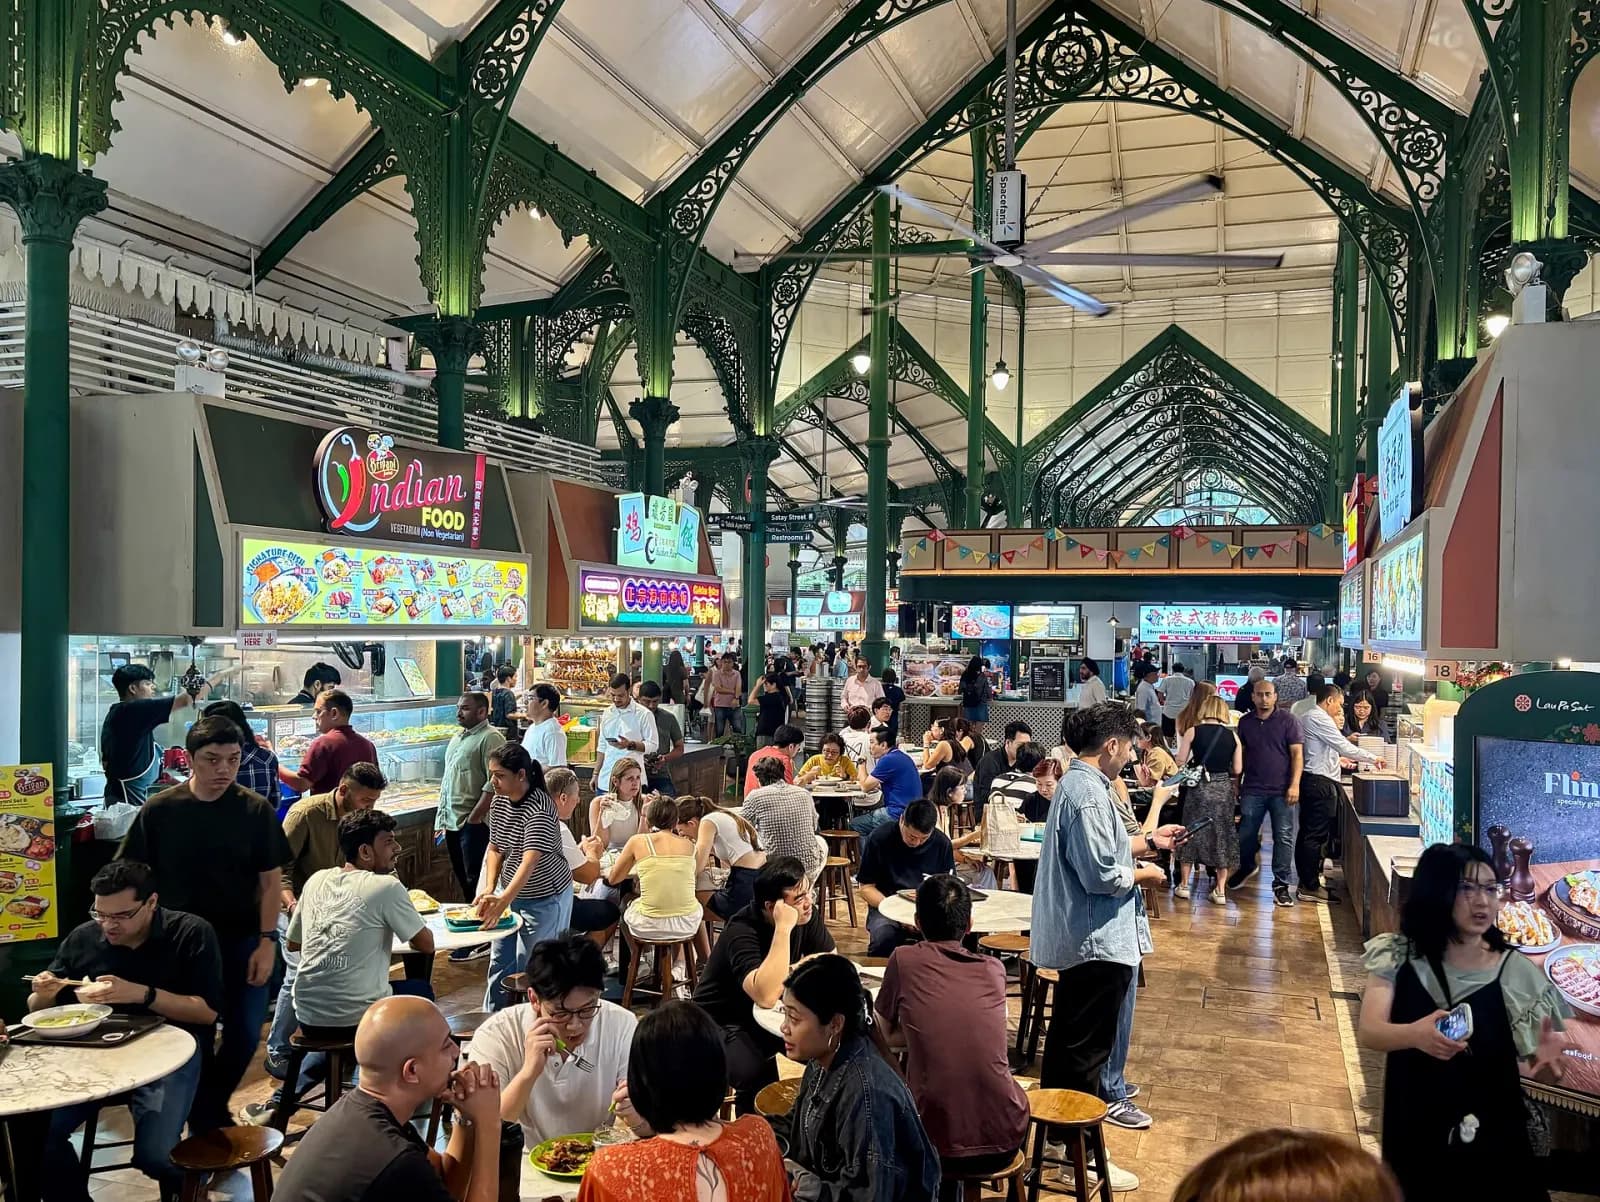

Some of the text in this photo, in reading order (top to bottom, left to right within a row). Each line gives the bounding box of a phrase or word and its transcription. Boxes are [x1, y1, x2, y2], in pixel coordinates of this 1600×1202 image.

[999, 176, 1008, 225] Spacefans
[421, 507, 465, 531] FOOD
[771, 513, 806, 522] Satay Street
[390, 523, 465, 543] VEGETARIAN (Non Vegetarian)
[771, 534, 804, 542] Restrooms
[246, 548, 287, 574] SIGNATURE
[244, 638, 261, 646] HERE
[1367, 652, 1378, 661] 16
[1433, 665, 1451, 677] 18
[1536, 697, 1596, 712] Lau Pa Sat
[1543, 770, 1600, 799] Flin
